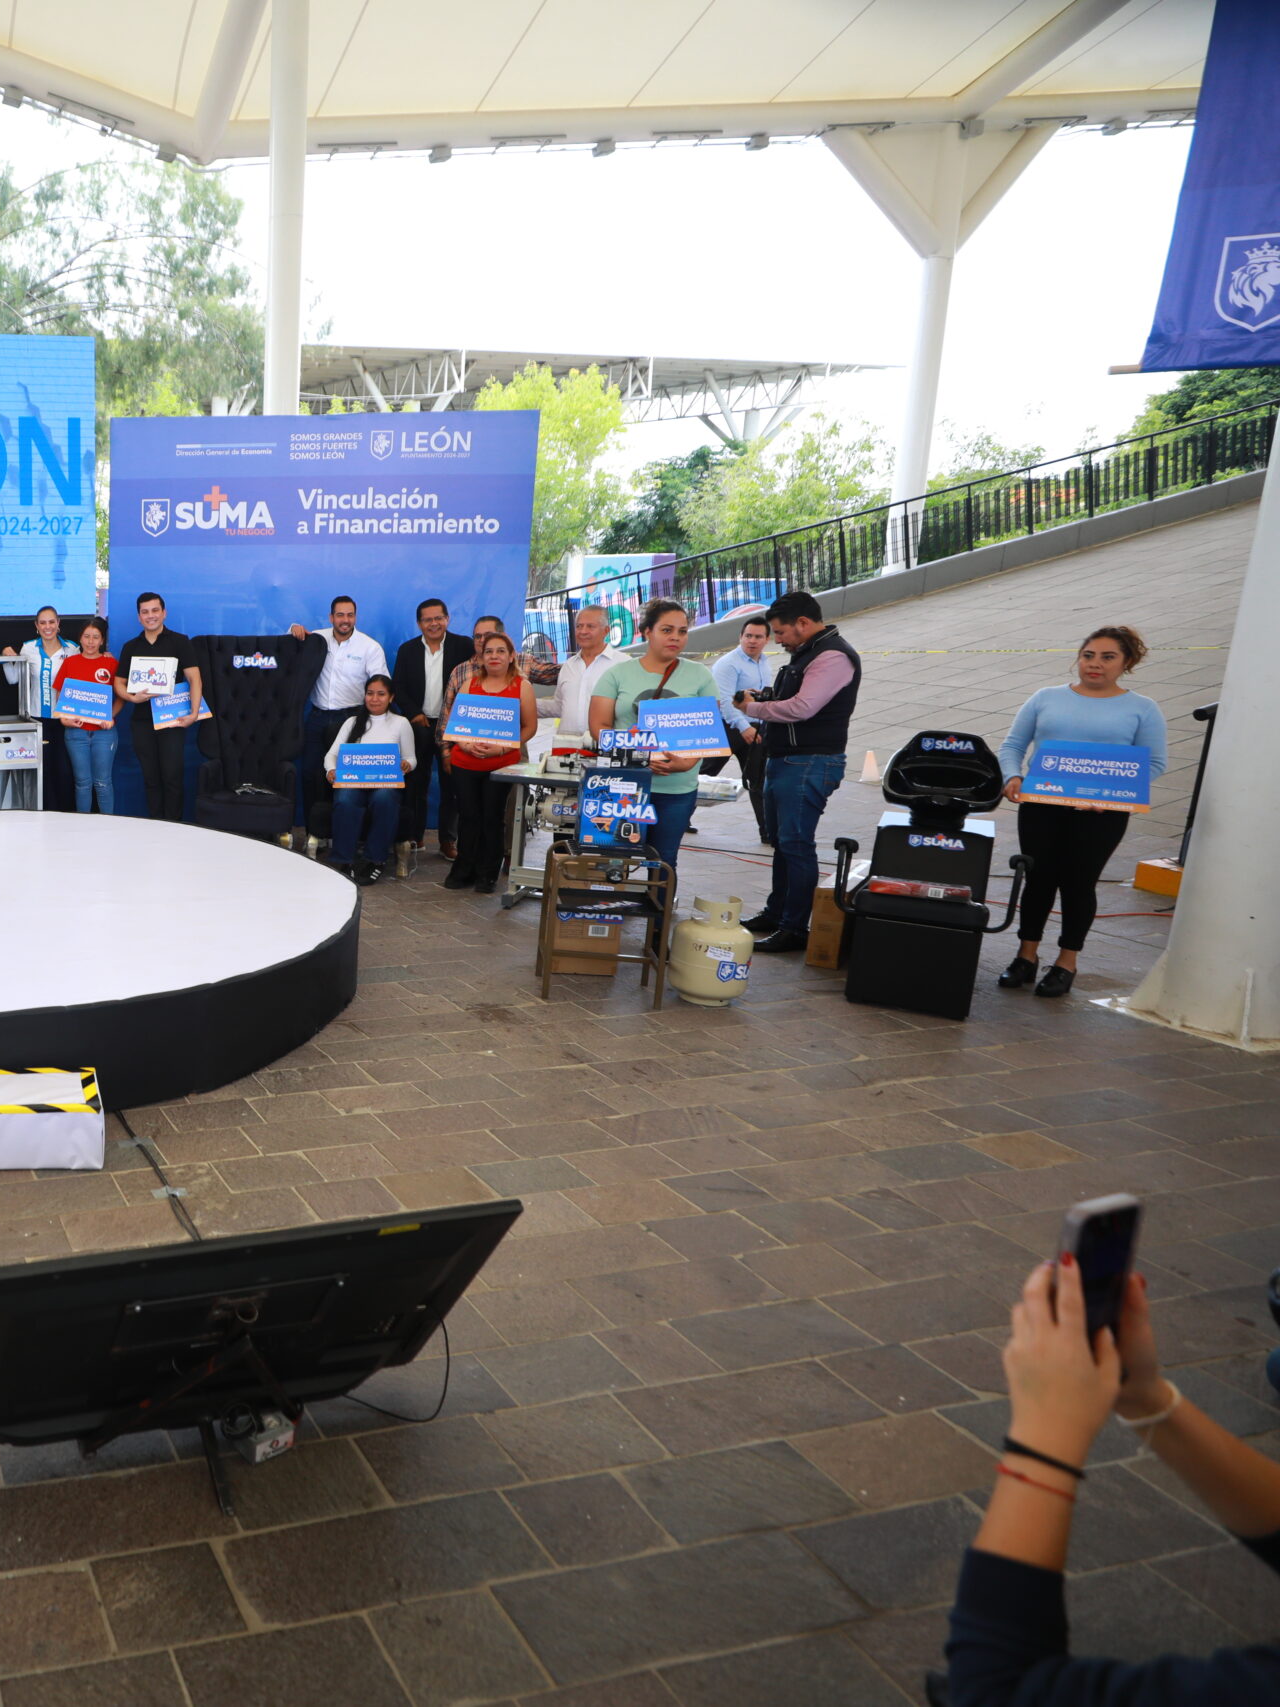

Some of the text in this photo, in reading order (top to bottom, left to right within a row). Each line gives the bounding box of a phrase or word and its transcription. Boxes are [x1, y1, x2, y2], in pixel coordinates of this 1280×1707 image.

[290, 432, 363, 442] SOMOS GRANDES
[401, 426, 472, 452] LEÓN
[290, 442, 358, 451] SOMOS FUERTES
[206, 448, 230, 456] General
[231, 448, 240, 456] de
[241, 448, 272, 456] Economía
[290, 450, 345, 460] SOMOS LEÓN
[297, 487, 438, 510] Vinculación
[175, 501, 275, 530] SUMA
[297, 513, 500, 535] a Financiamiento
[225, 528, 275, 536] TU NEGOCIO
[244, 656, 277, 666] SUMA
[140, 672, 167, 683] SUMA
[468, 706, 514, 716] EQUIPAMIENTO
[657, 711, 714, 721] EQUIPAMIENTO
[467, 712, 514, 722] PRODUCTIVO
[658, 719, 714, 728] PRODUCTIVO
[615, 732, 658, 747] SUMA
[935, 739, 975, 751] SUMA
[1059, 757, 1140, 770] EQUIPAMIENTO
[1058, 765, 1138, 778] PRODUCTIVO
[587, 775, 623, 790] Oster
[1035, 783, 1064, 793] SUMA
[1111, 789, 1137, 798] LEÓN
[601, 802, 657, 819] SUMA
[923, 836, 965, 849] SUMA
